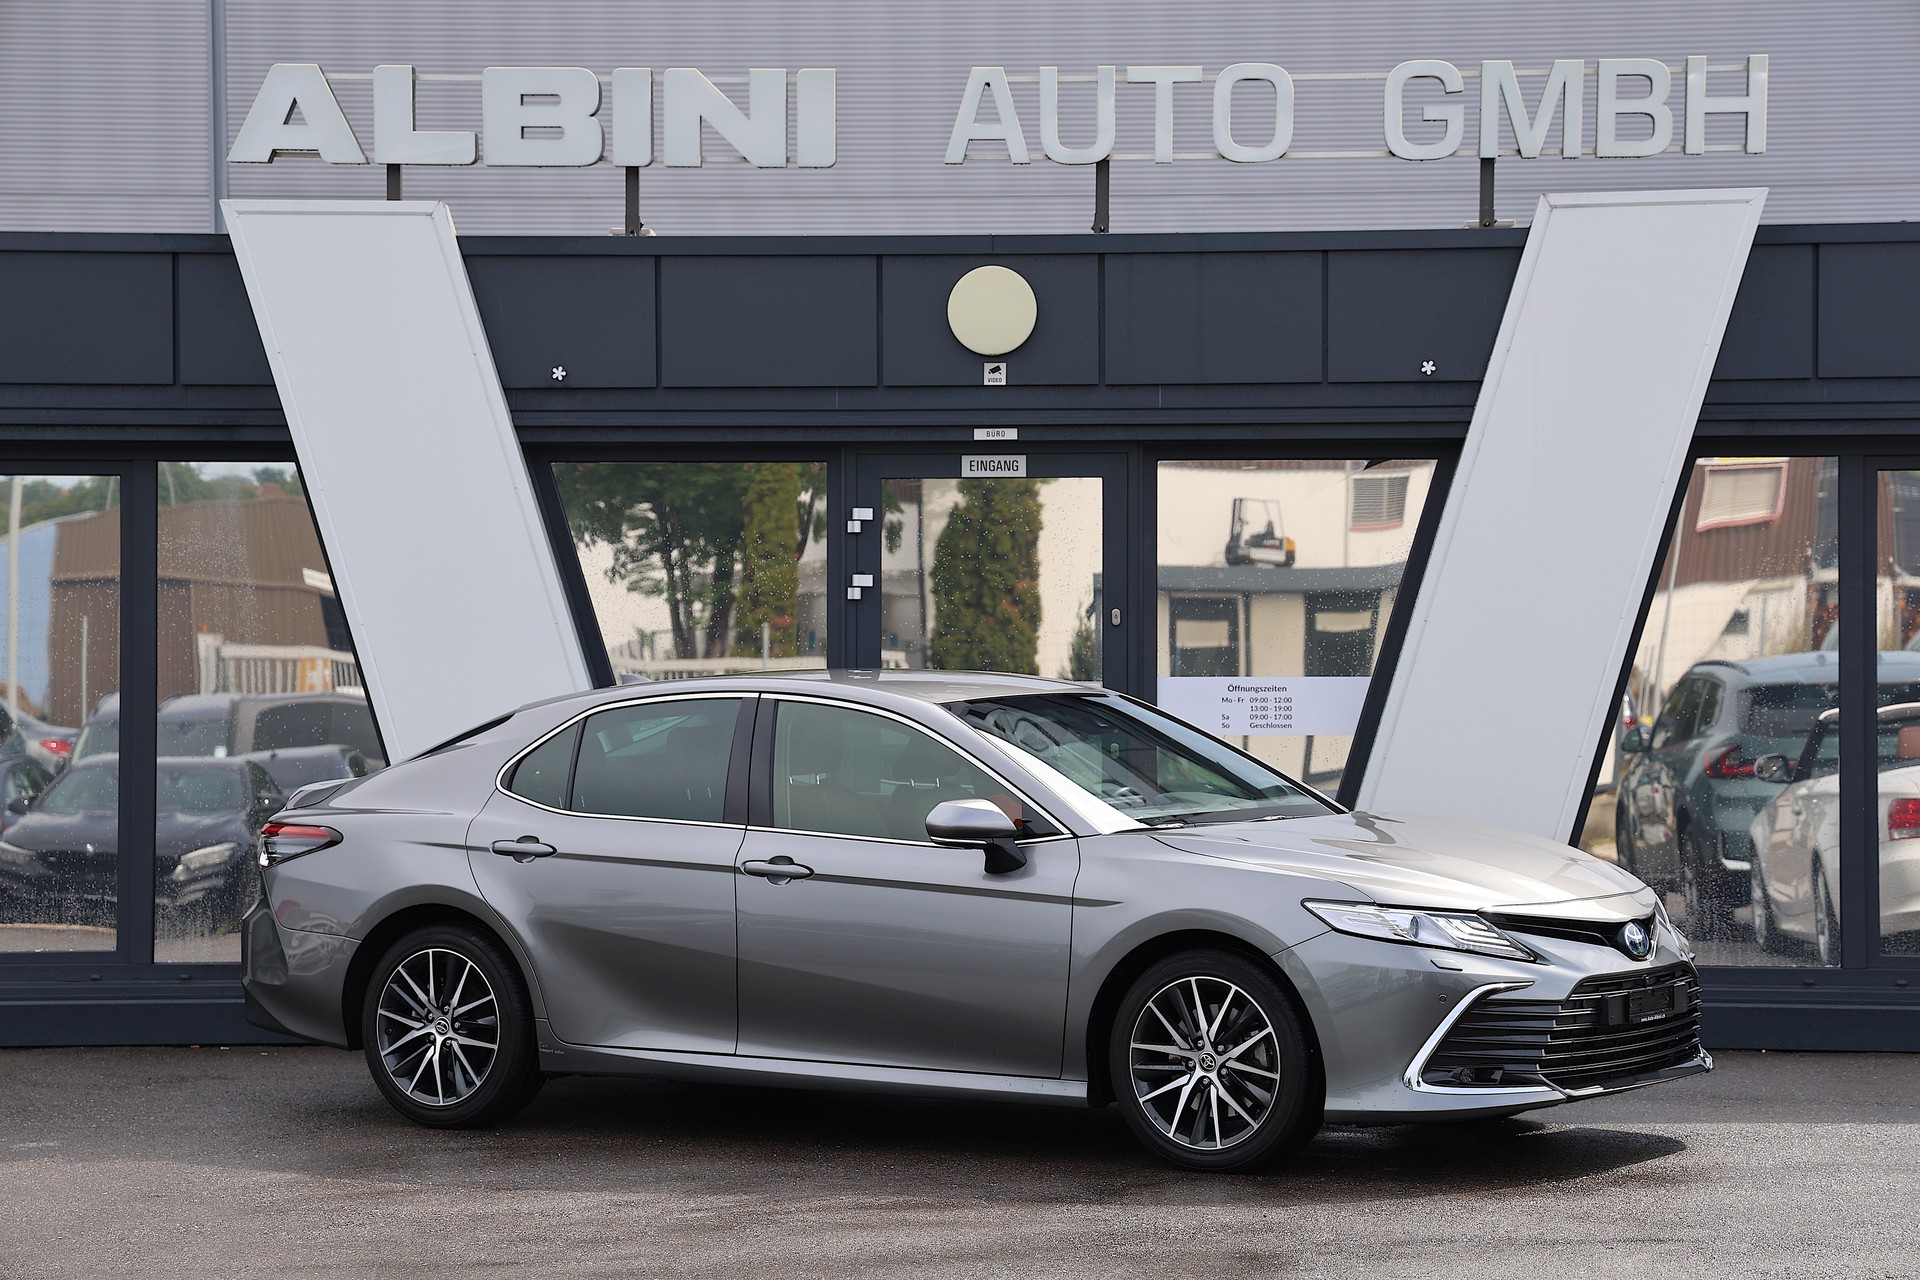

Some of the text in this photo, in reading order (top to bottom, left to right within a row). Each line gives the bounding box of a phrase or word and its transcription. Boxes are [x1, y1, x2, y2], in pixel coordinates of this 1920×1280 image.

[226, 54, 1769, 168] ALBINI AUTO GMBH
[969, 460, 1019, 472] EINGANG
[1227, 684, 1287, 694] Öffnungszeiten
